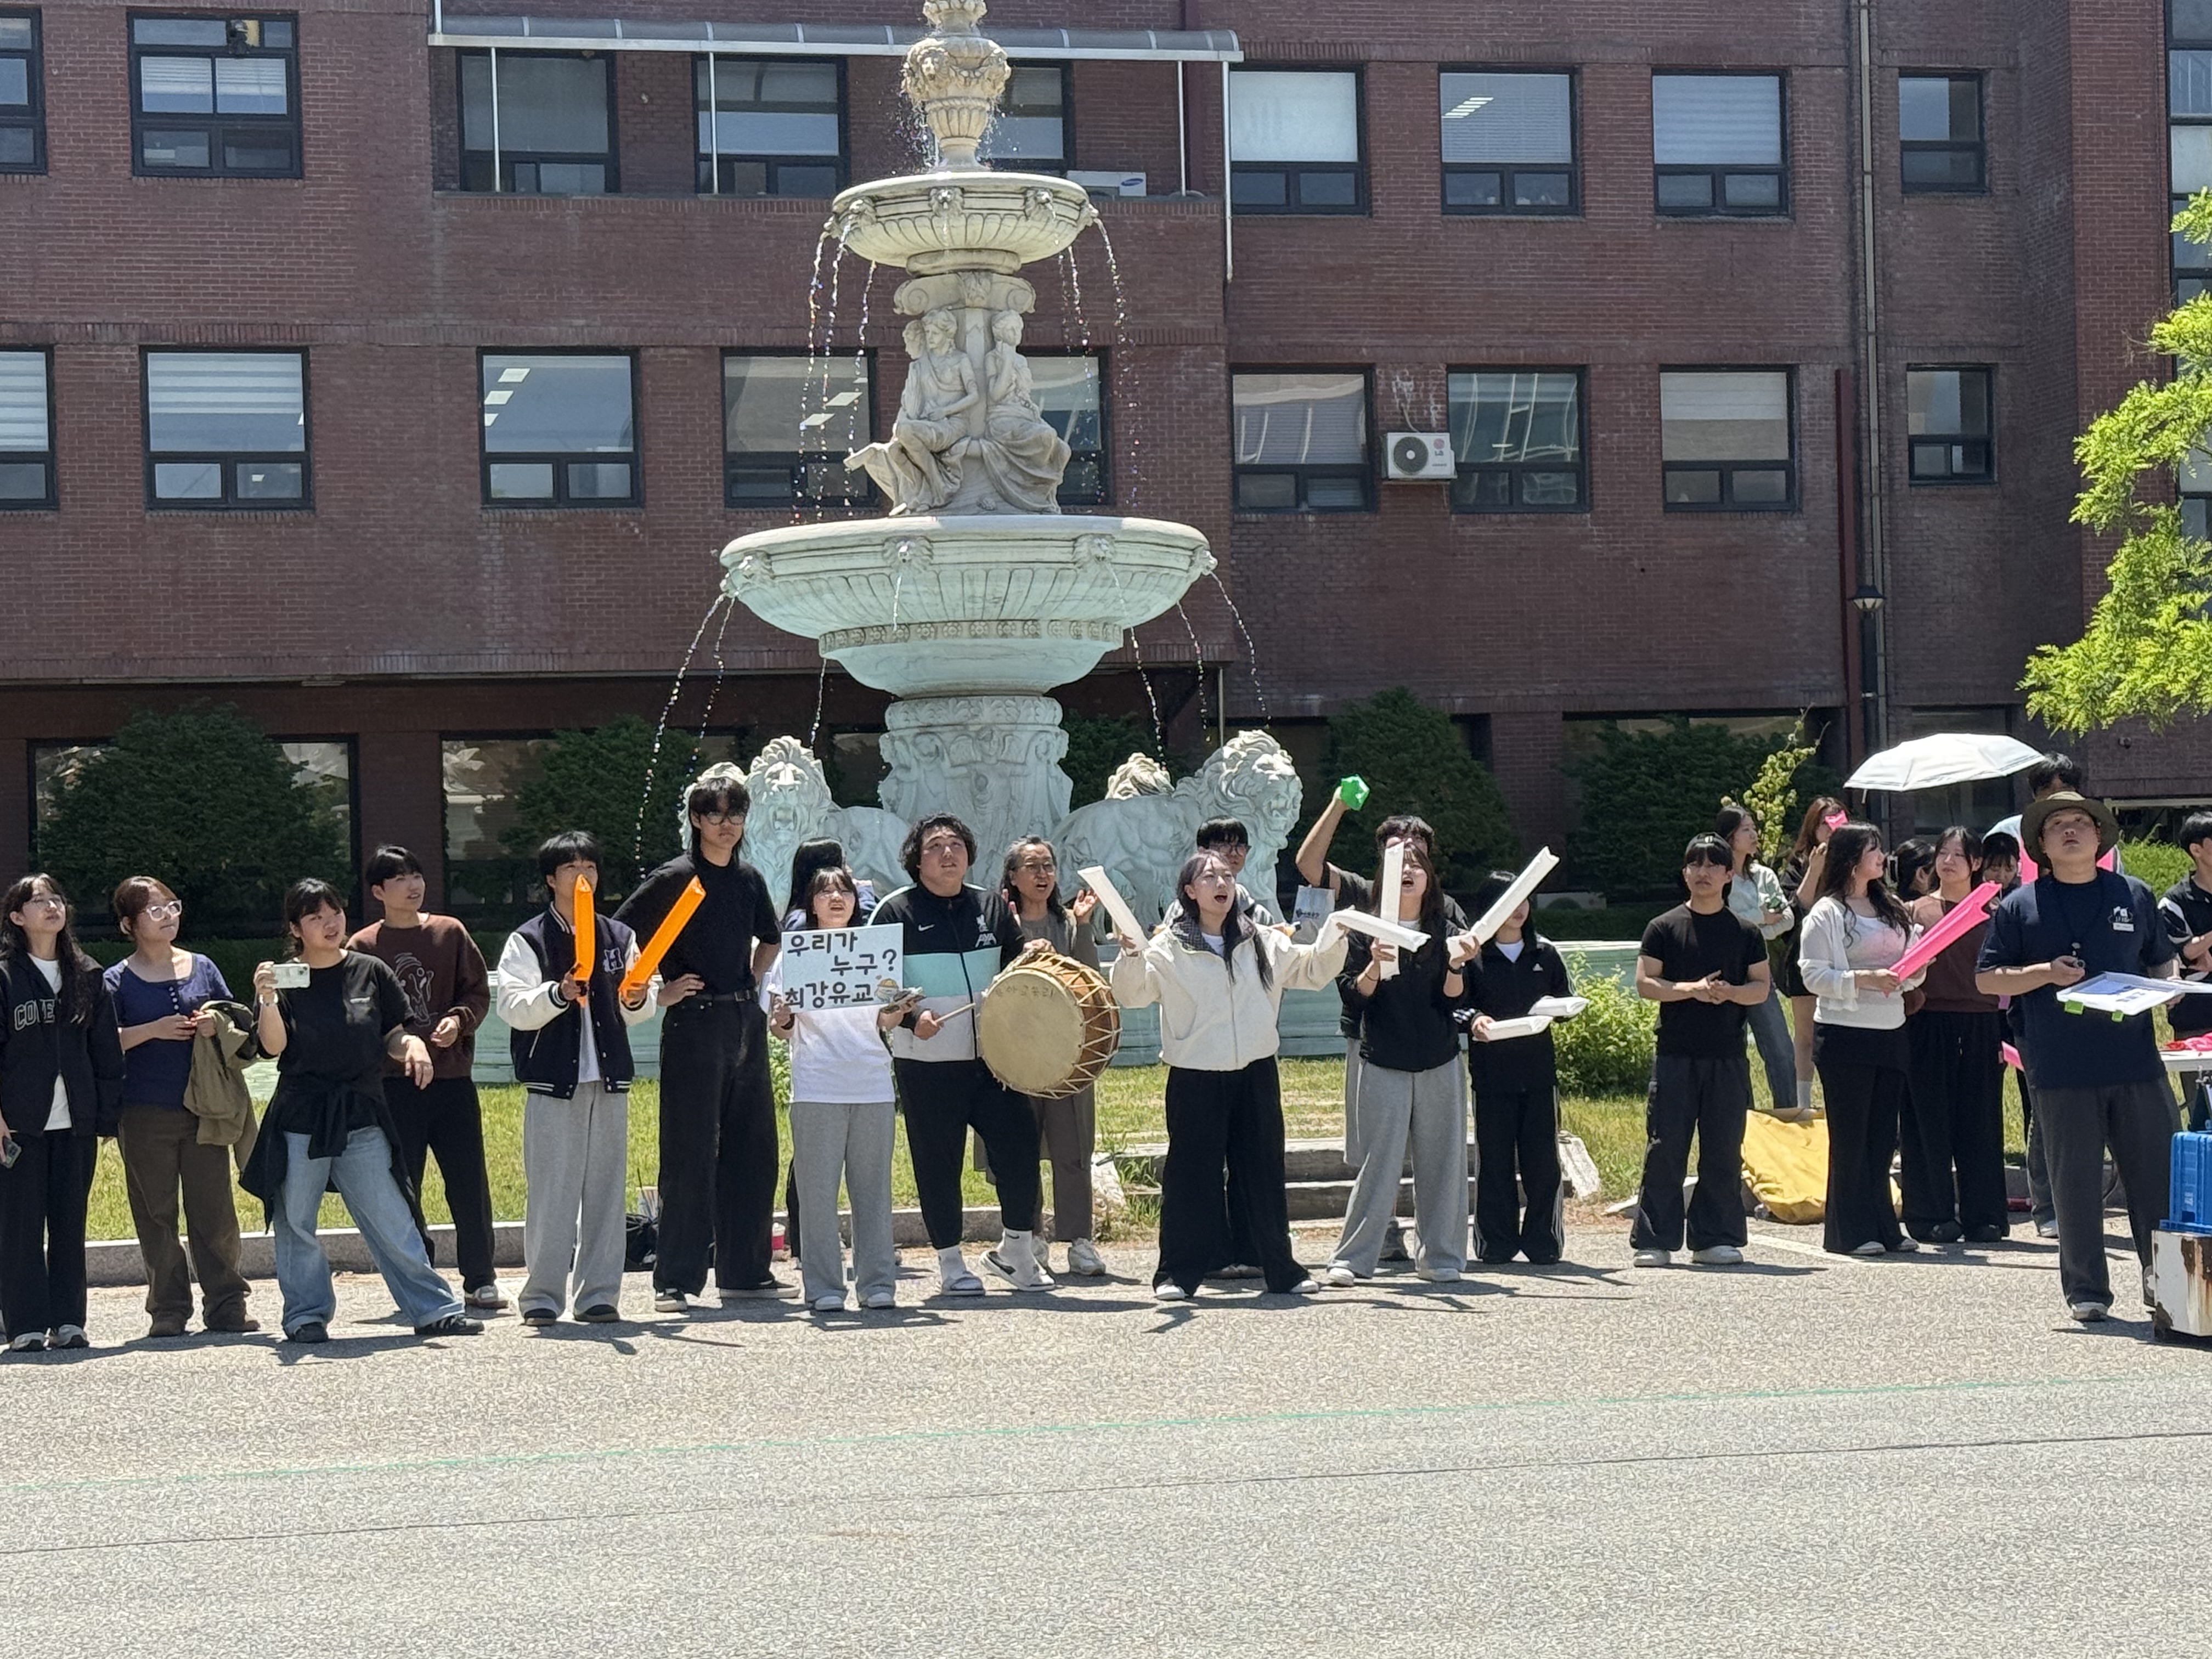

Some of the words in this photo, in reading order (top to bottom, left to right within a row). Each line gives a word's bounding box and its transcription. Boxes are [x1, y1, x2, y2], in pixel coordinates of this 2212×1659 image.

[787, 931, 858, 957] 우리가
[830, 949, 897, 976] 누구?
[784, 980, 874, 1008] 최강유교
